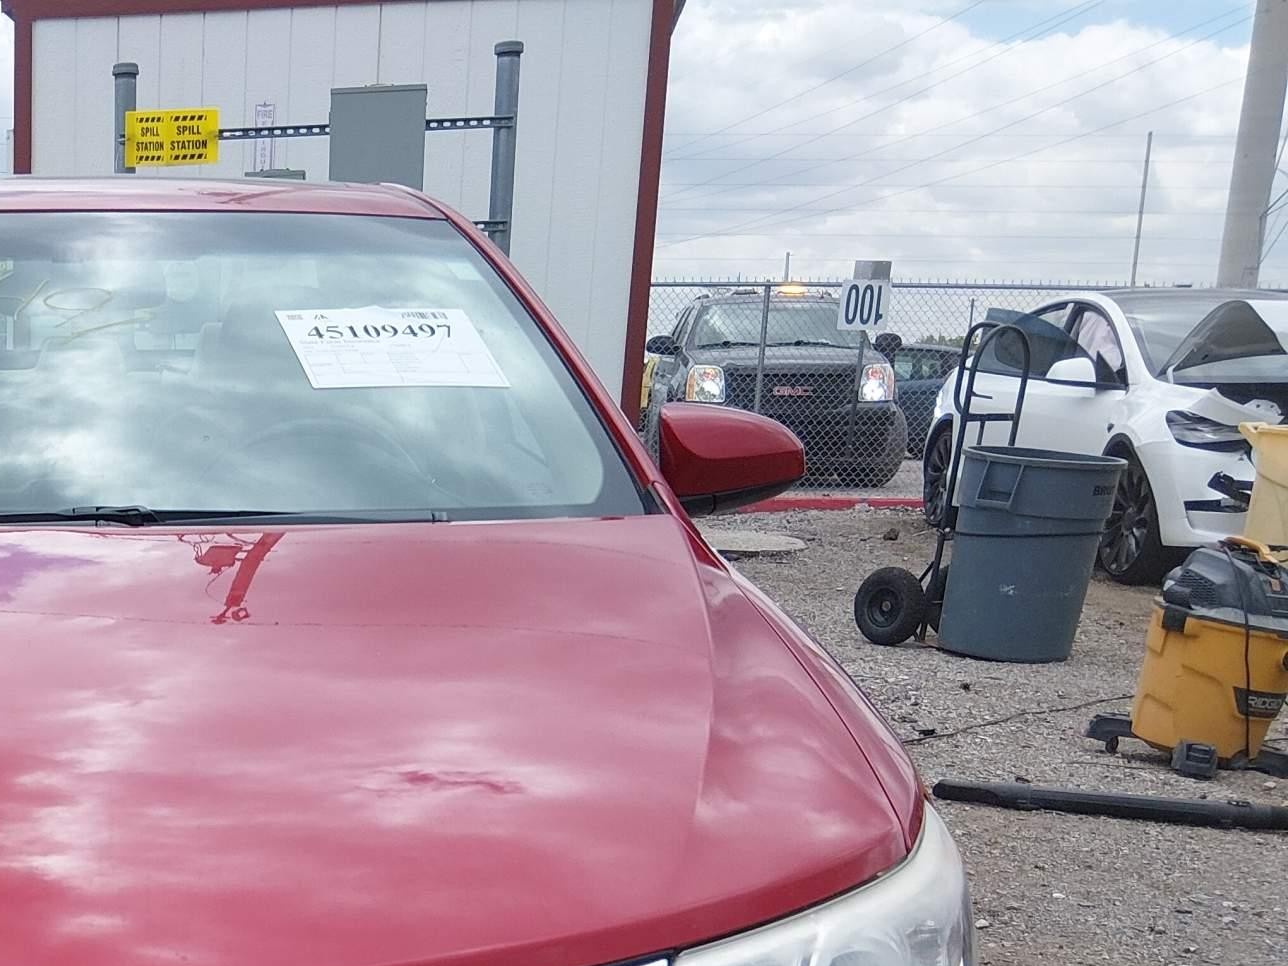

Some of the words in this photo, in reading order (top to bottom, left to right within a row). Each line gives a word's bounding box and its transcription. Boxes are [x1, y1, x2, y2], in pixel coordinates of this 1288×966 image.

[140, 127, 159, 137] SPILL
[176, 125, 201, 136] SPILL
[136, 141, 164, 152] STATION
[170, 139, 207, 151] STATION
[844, 283, 883, 326] 100
[307, 323, 451, 340] 45109497
[773, 386, 813, 396] GMC
